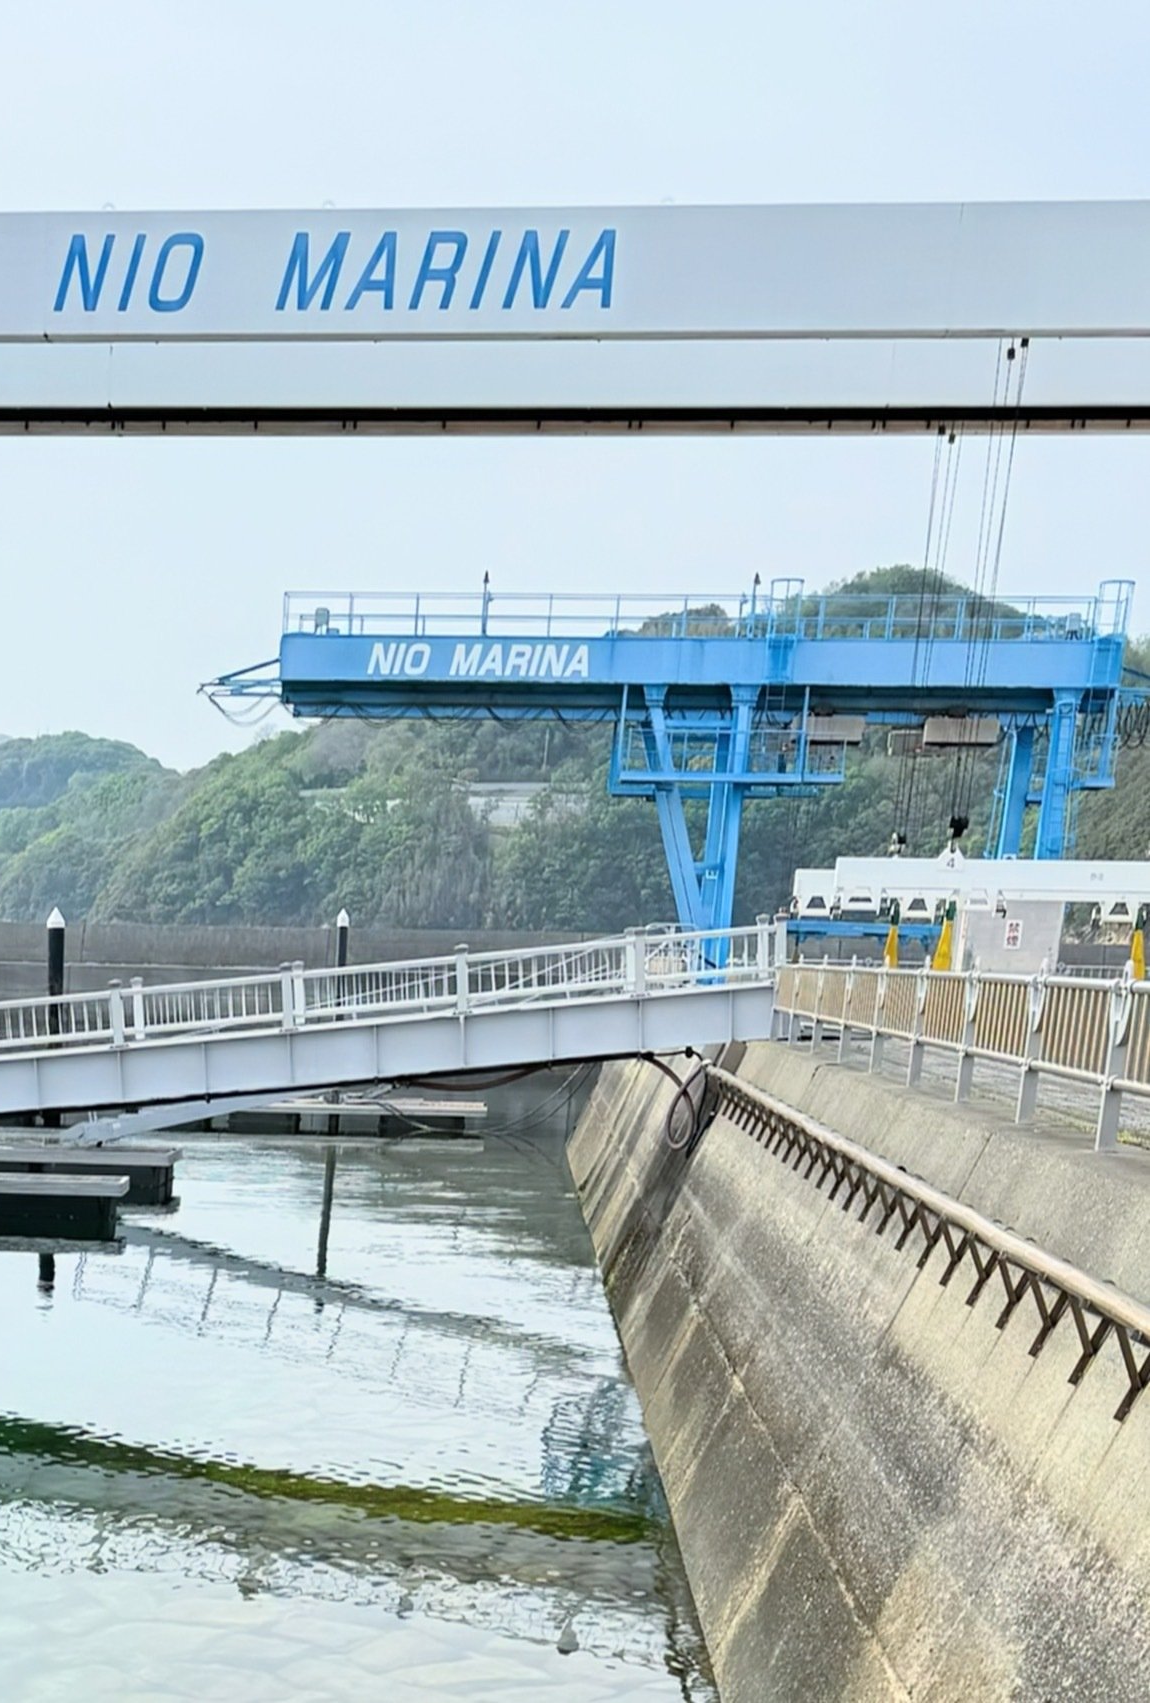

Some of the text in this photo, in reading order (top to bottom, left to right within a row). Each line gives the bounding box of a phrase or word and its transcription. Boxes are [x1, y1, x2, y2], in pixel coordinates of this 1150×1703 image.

[53, 229, 617, 313] NIO MARINA
[367, 642, 589, 678] NIO MARINA
